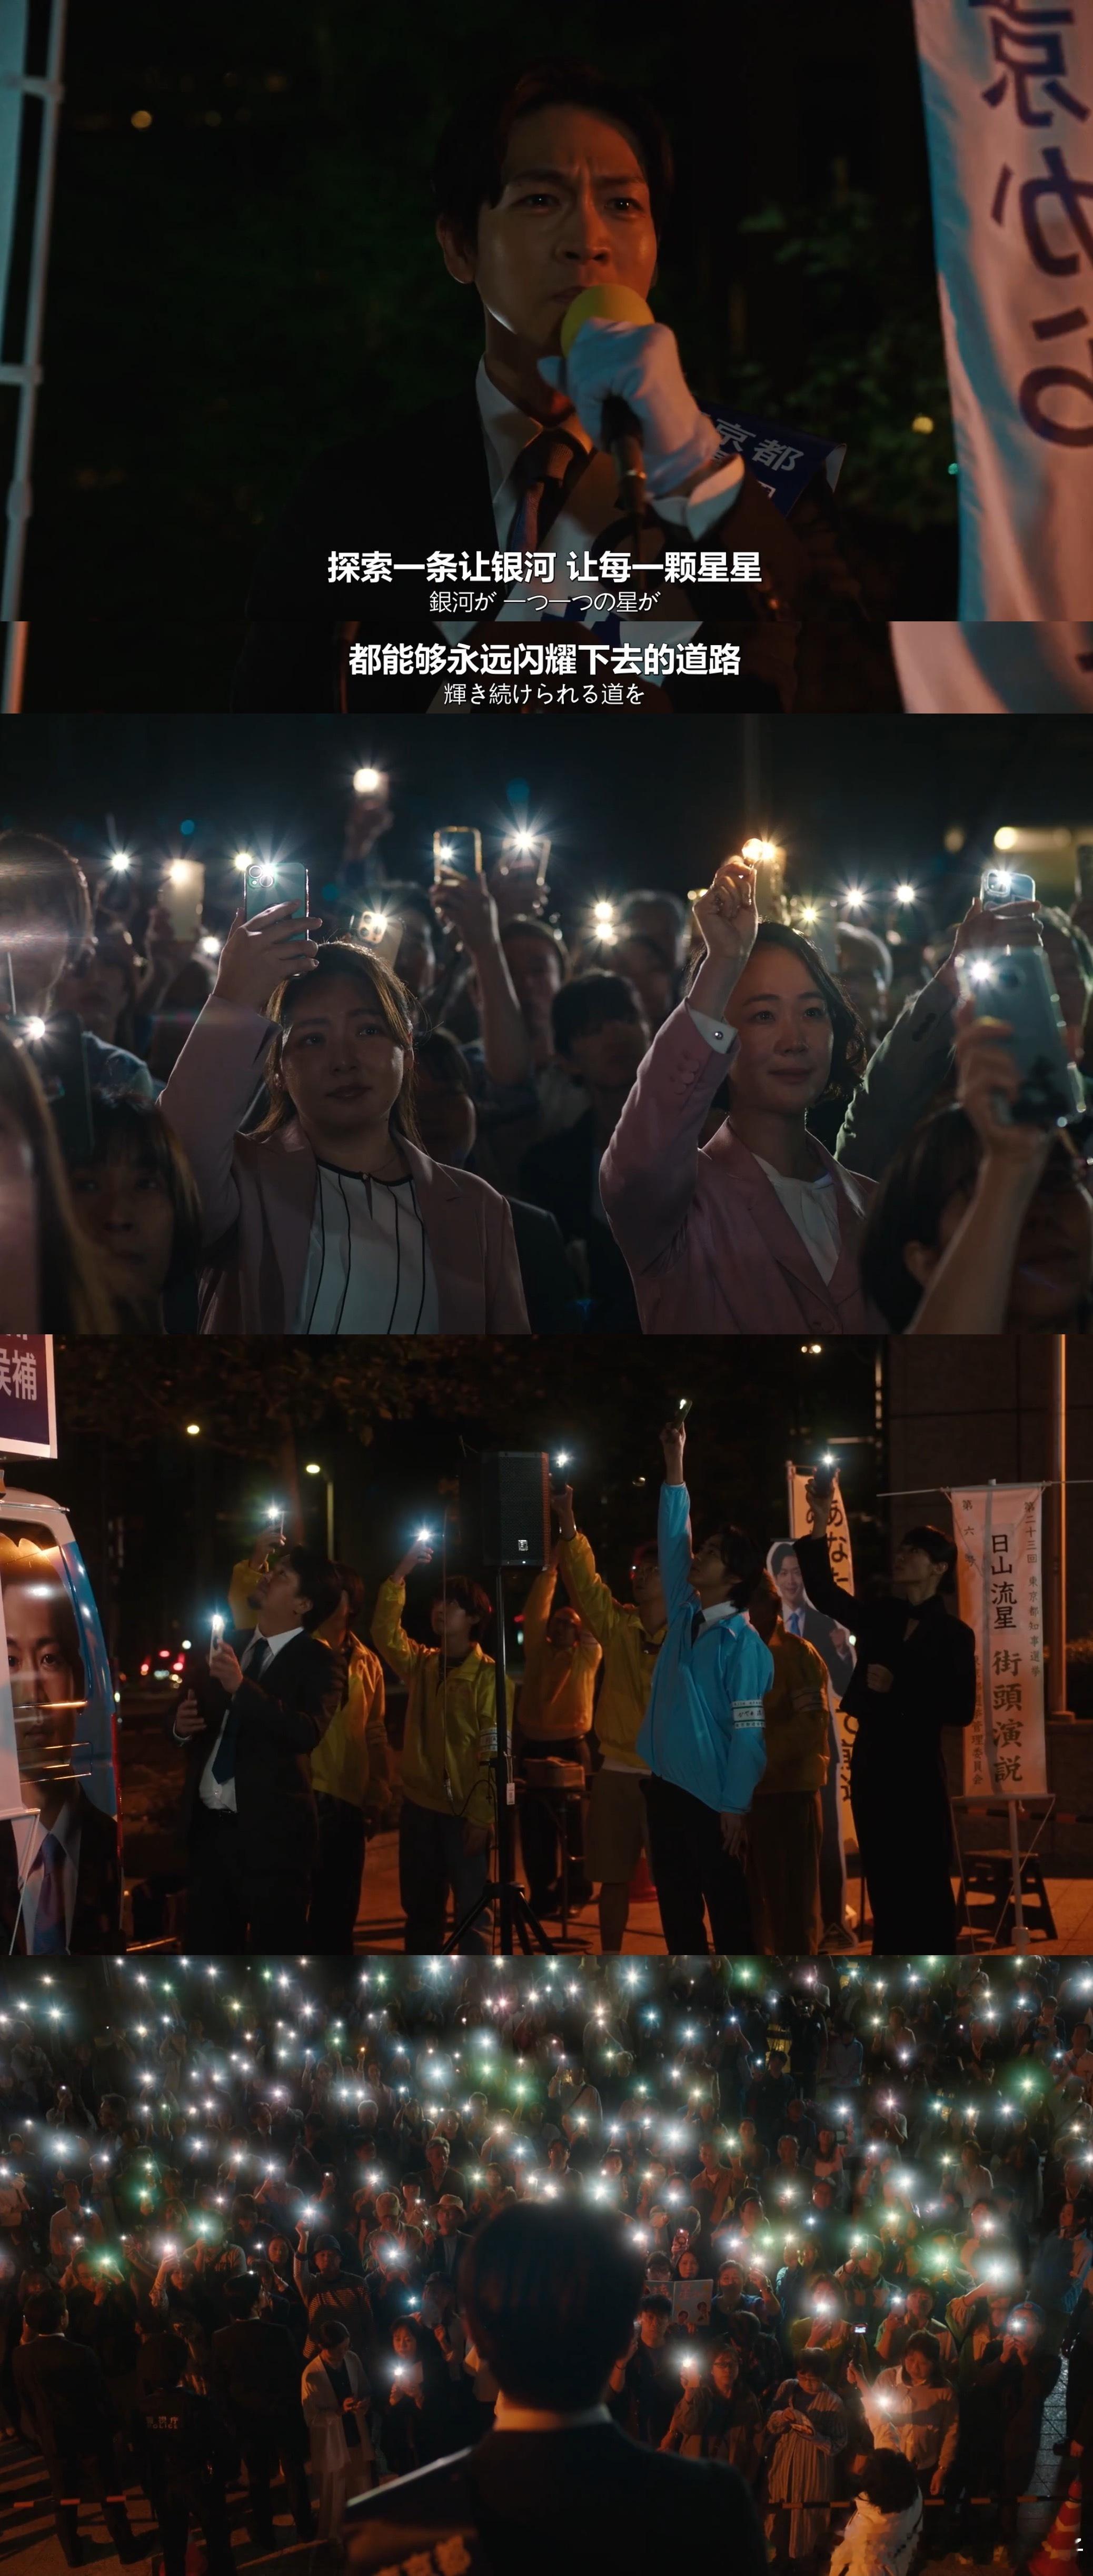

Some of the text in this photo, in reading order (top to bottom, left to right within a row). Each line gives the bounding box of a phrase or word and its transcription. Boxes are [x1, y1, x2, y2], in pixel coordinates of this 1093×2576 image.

[702, 412, 804, 471] 京都
[991, 1534, 1024, 1783] 日山流星 街頭演説
[1025, 1502, 1041, 1677] 第二十三回 東京都知事選挙
